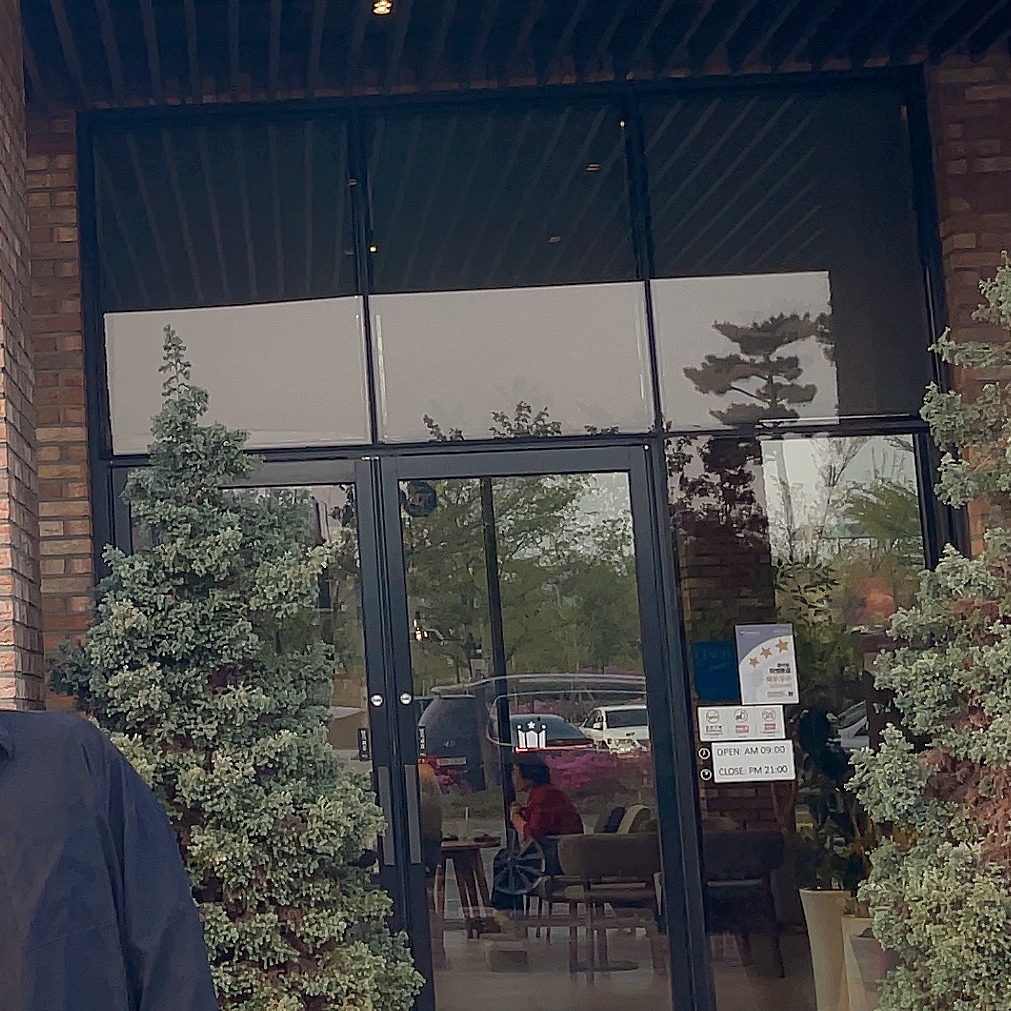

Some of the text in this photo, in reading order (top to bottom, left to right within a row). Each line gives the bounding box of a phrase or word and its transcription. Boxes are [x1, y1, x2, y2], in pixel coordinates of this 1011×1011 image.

[744, 747, 758, 755] AM
[760, 746, 786, 754] 09:00
[749, 766, 762, 775] PM
[764, 765, 788, 774] 21:00
